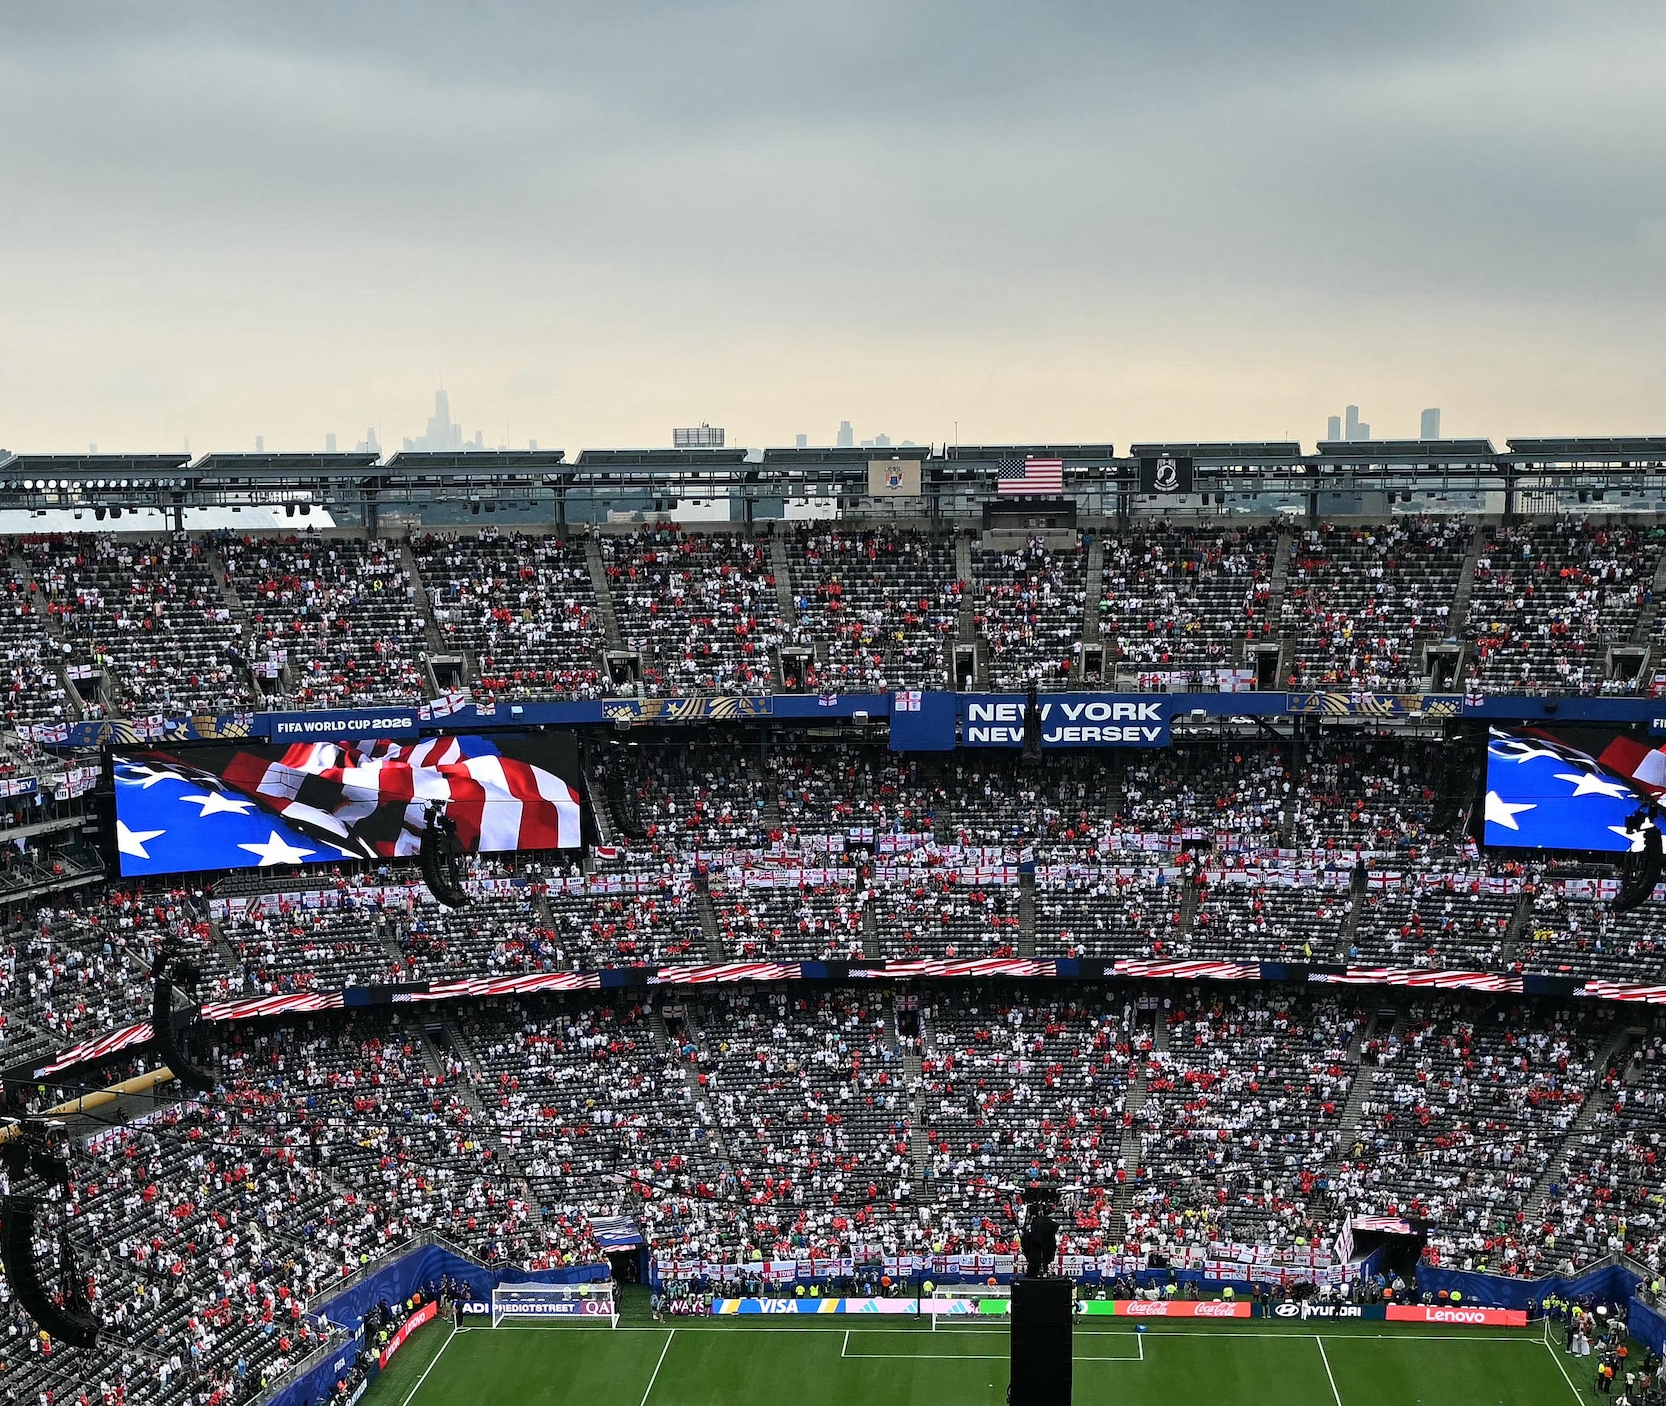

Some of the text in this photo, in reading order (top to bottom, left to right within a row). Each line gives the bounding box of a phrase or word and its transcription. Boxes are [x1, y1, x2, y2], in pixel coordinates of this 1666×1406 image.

[968, 702, 1162, 722] NEW YORK
[277, 717, 412, 733] FIFA WORLD CUP 2026
[1043, 726, 1162, 742] JERSEY
[462, 1303, 489, 1314] ADI
[586, 1301, 615, 1314] QAT
[756, 1298, 798, 1313] VISA
[1126, 1300, 1237, 1317] Coca-Cola Coca-Cola
[1425, 1308, 1486, 1323] Lenovo
[405, 1312, 426, 1336] Lenovo
[385, 1335, 400, 1360] Lenovo
[334, 1357, 346, 1373] FIFA
